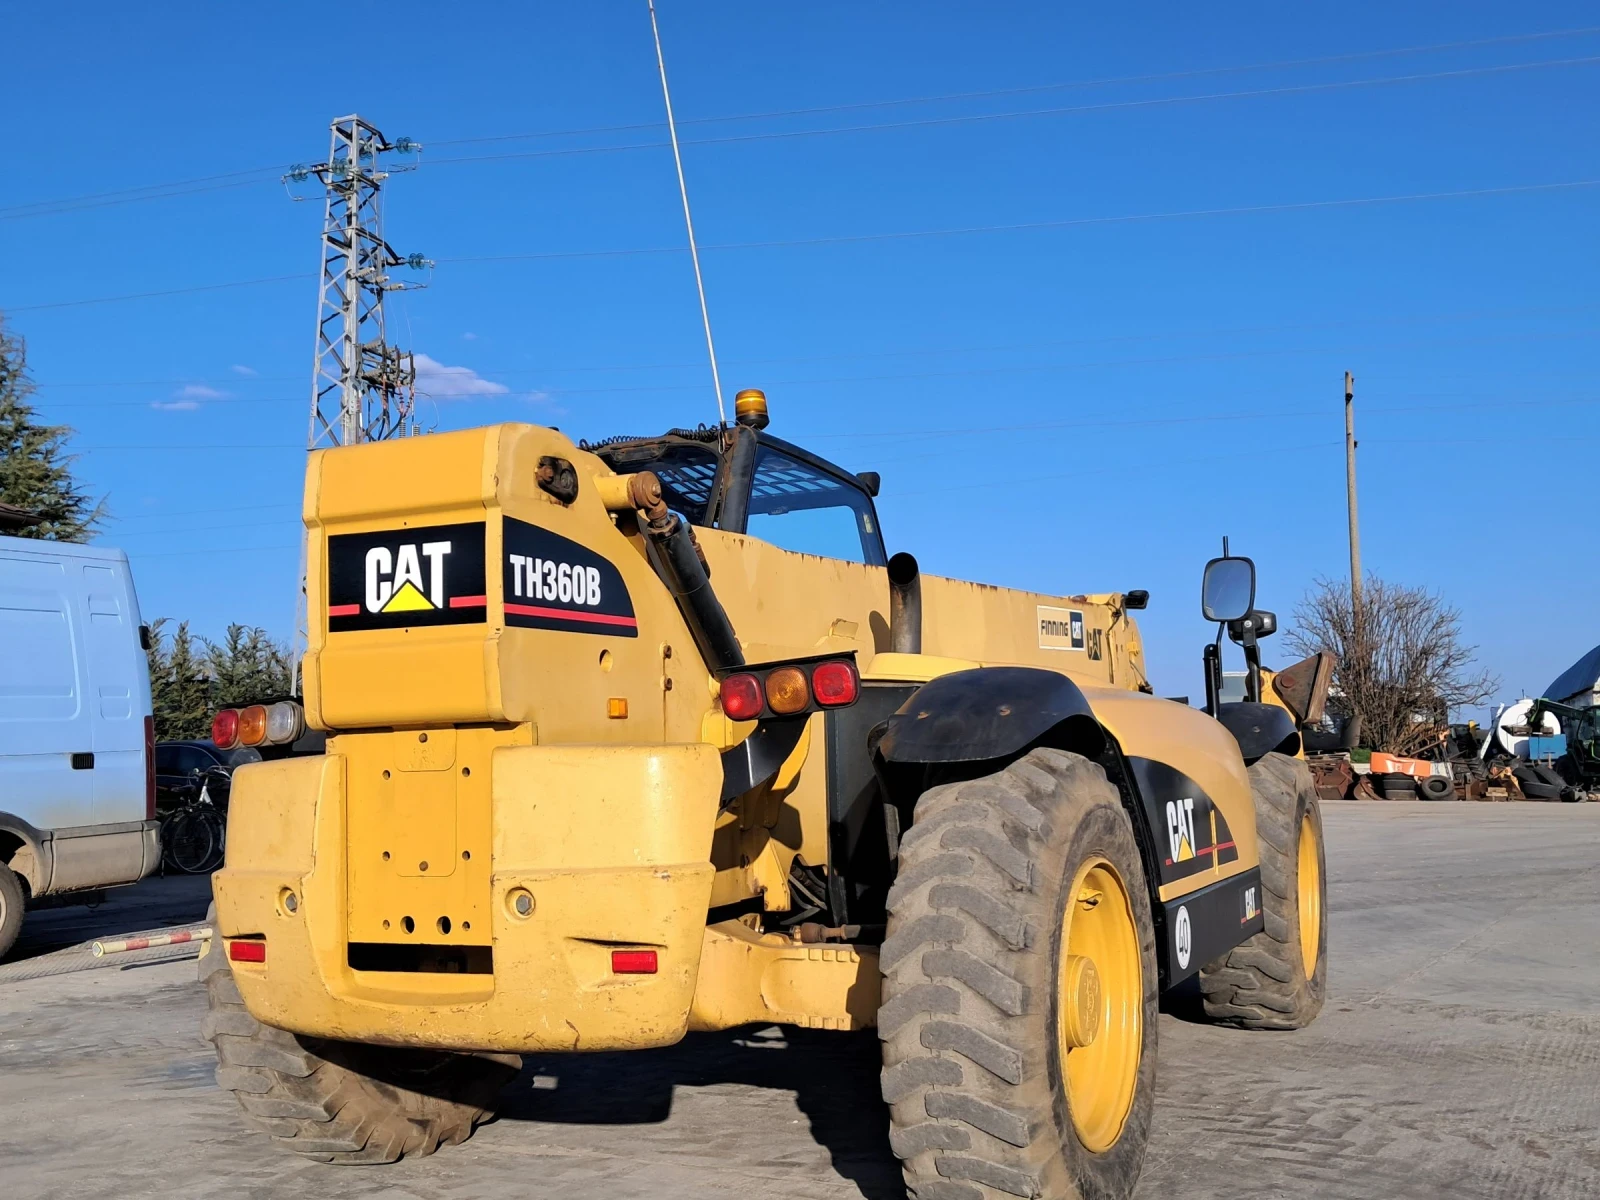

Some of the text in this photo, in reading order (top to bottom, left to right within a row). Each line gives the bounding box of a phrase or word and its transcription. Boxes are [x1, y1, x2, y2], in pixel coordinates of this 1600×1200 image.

[365, 541, 451, 613] CAT
[510, 554, 600, 606] TH360B
[1072, 620, 1082, 639] CAT
[1086, 628, 1102, 661] CAT
[1166, 798, 1196, 863] CAT
[1245, 887, 1255, 920] CAT
[1179, 917, 1188, 957] 40
